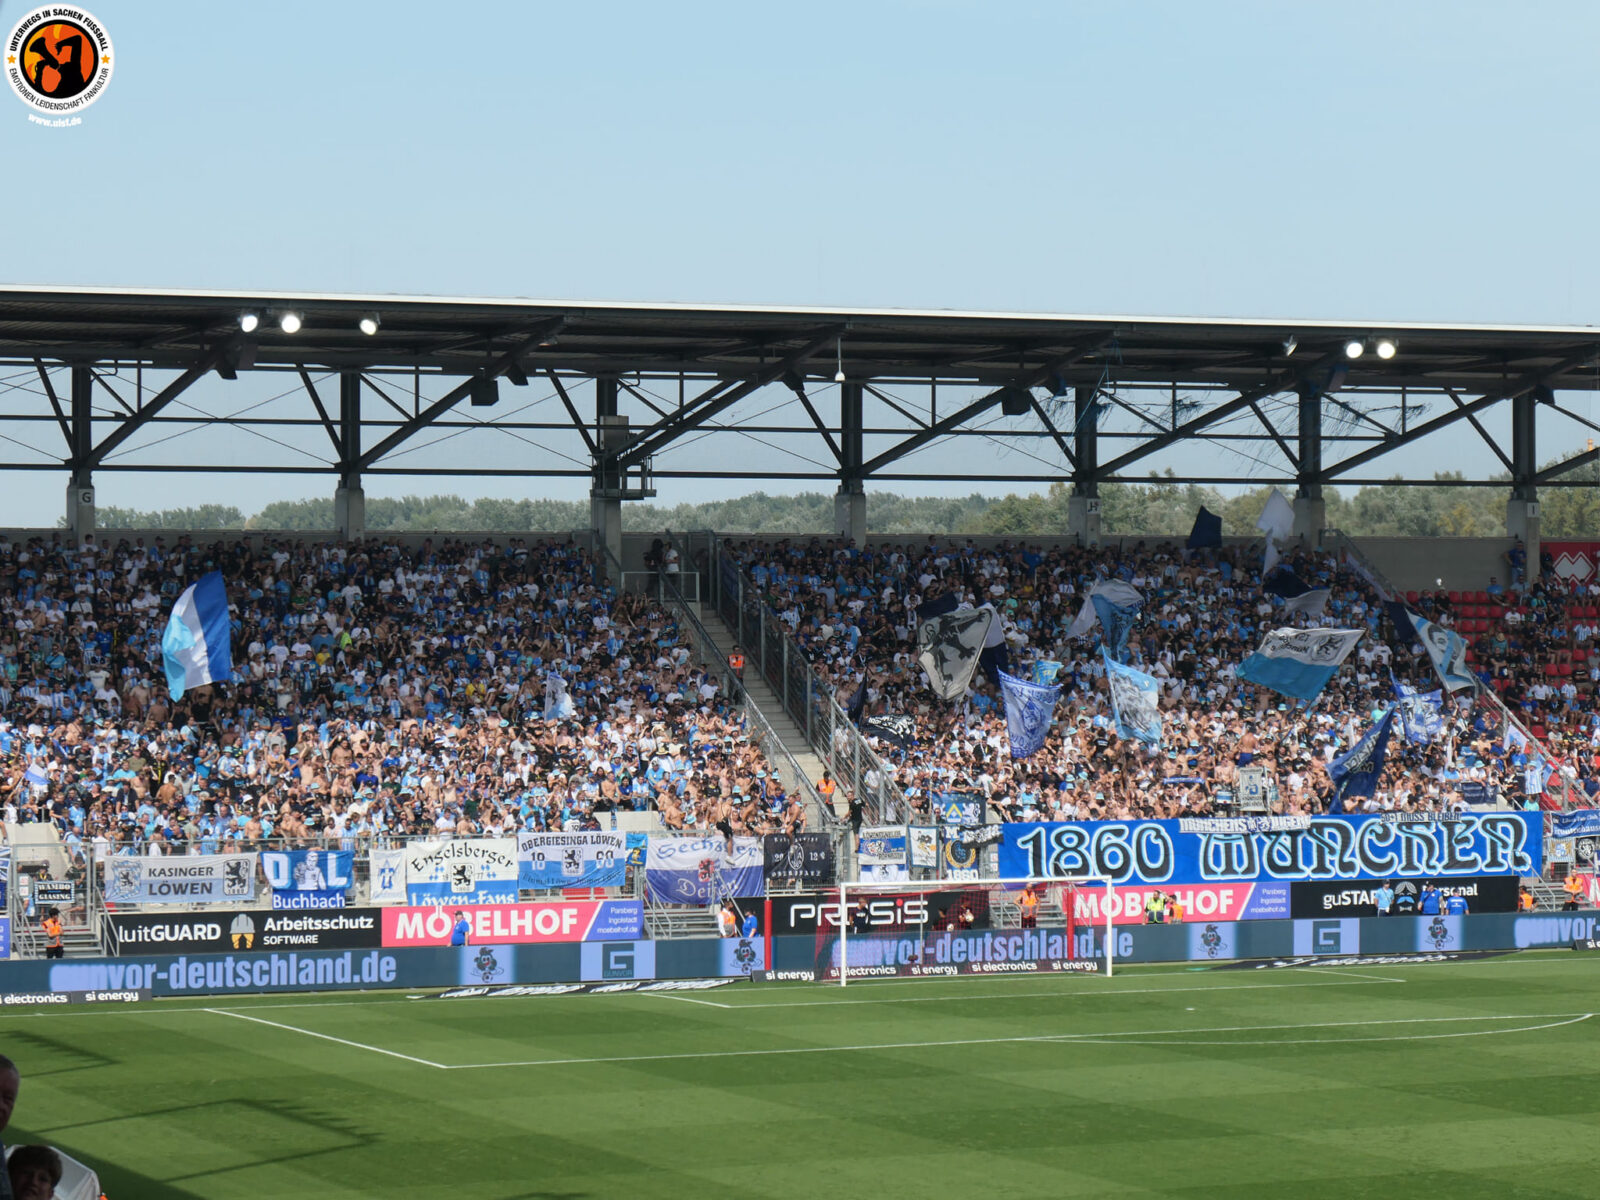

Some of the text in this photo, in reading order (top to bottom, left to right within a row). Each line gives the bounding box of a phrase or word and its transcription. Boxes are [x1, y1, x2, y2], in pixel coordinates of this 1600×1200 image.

[82, 491, 91, 503] G
[1401, 812, 1424, 822] MUSS
[521, 833, 622, 852] OBERGIESINGA LÖWEN
[656, 838, 757, 859] Sechzer
[411, 842, 513, 872] Engelsberger
[1017, 823, 1174, 884] 1860
[148, 866, 214, 878] KASINGER
[148, 880, 213, 896] LÖWEN
[273, 893, 345, 909] Buchbach
[1074, 889, 1233, 919] MÖBHOF
[264, 915, 374, 931] Arbeitsschutz
[263, 935, 318, 945] SOFTWARE
[843, 965, 896, 977] lectronics
[911, 965, 958, 976] si energy
[972, 961, 1038, 972] si electronics
[1052, 960, 1097, 971] si energy
[765, 970, 814, 981] si energy
[85, 991, 139, 1002] si energy
